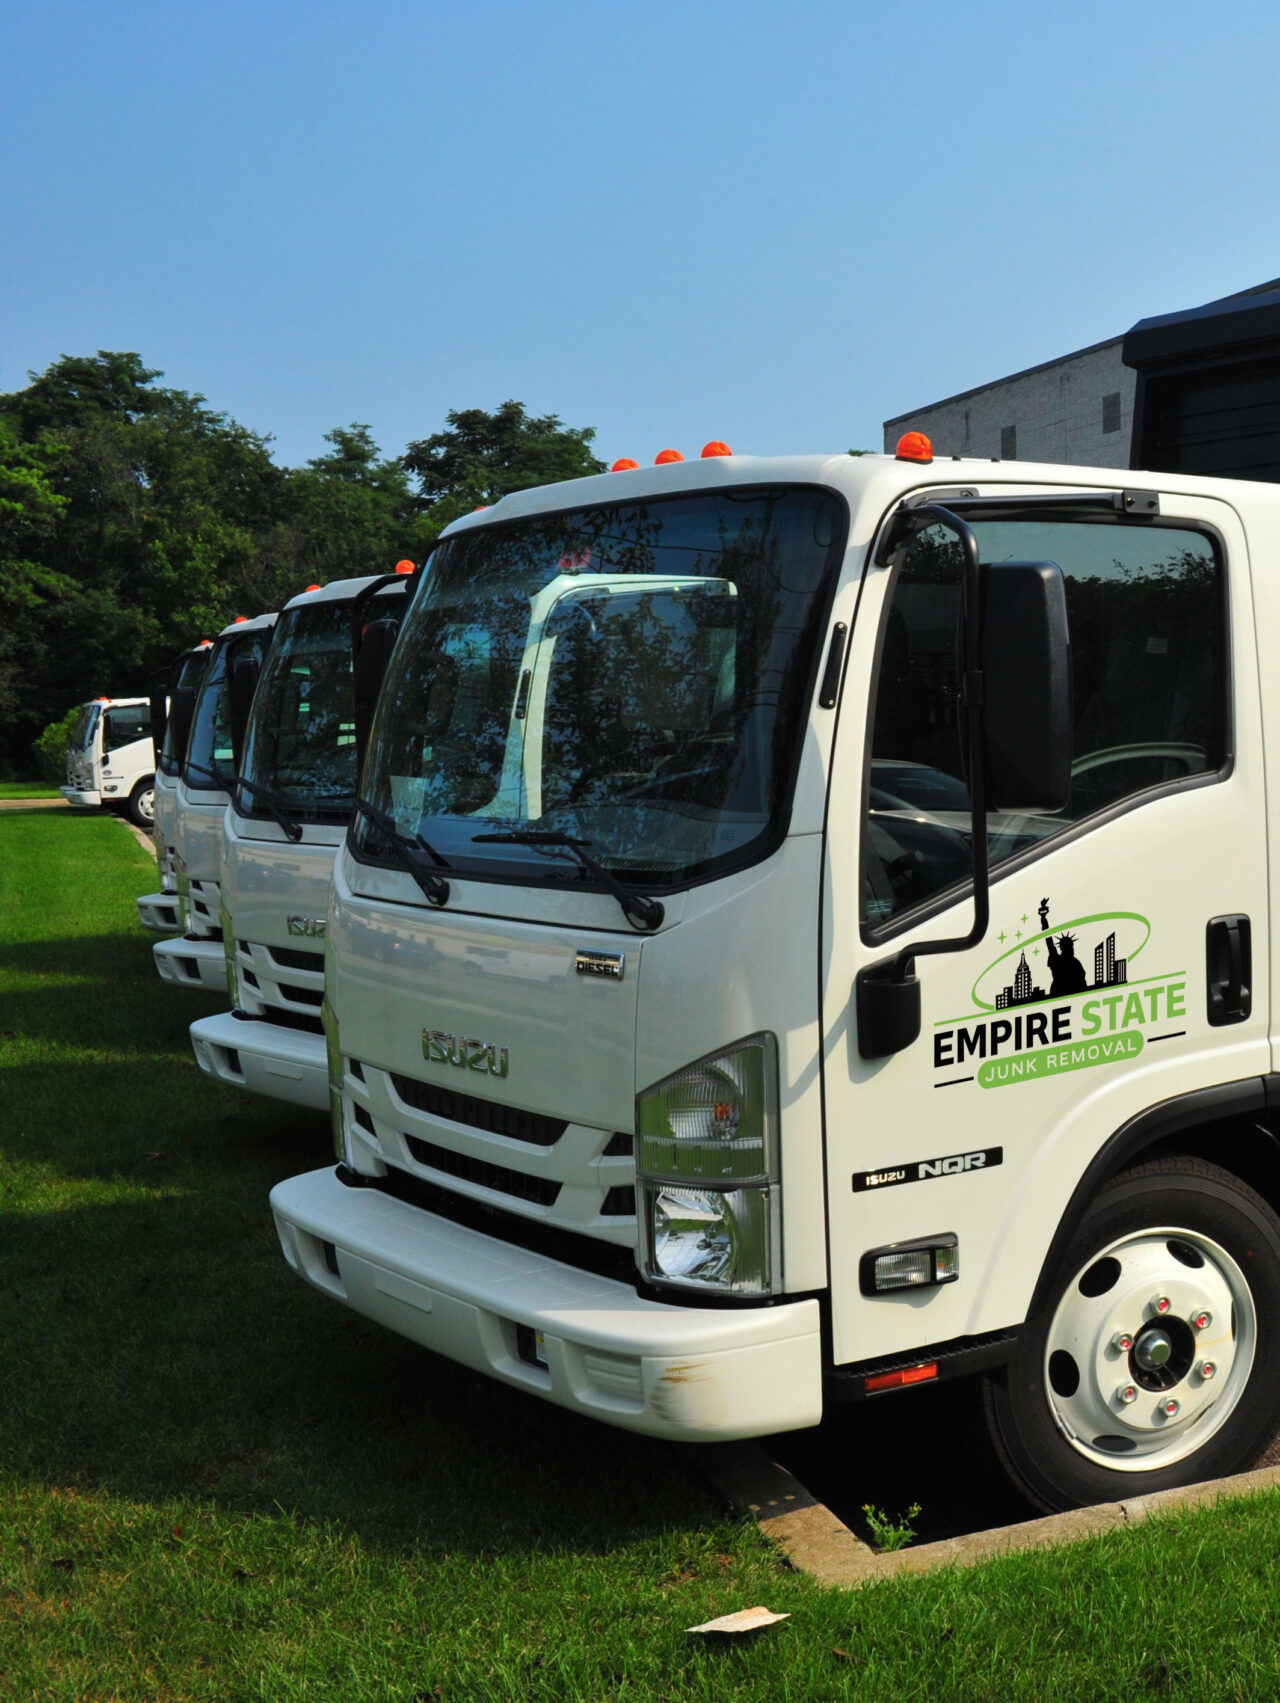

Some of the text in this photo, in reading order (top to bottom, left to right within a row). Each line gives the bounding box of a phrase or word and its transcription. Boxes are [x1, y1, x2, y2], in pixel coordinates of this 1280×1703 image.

[287, 915, 326, 938] ISUZ
[577, 961, 619, 976] DIESEL
[934, 981, 1186, 1068] EMPIRE STATE
[422, 1027, 509, 1078] ISUZU
[985, 1037, 1137, 1082] JUNK REMOVAL
[865, 1152, 987, 1186] ISUZU NQR
